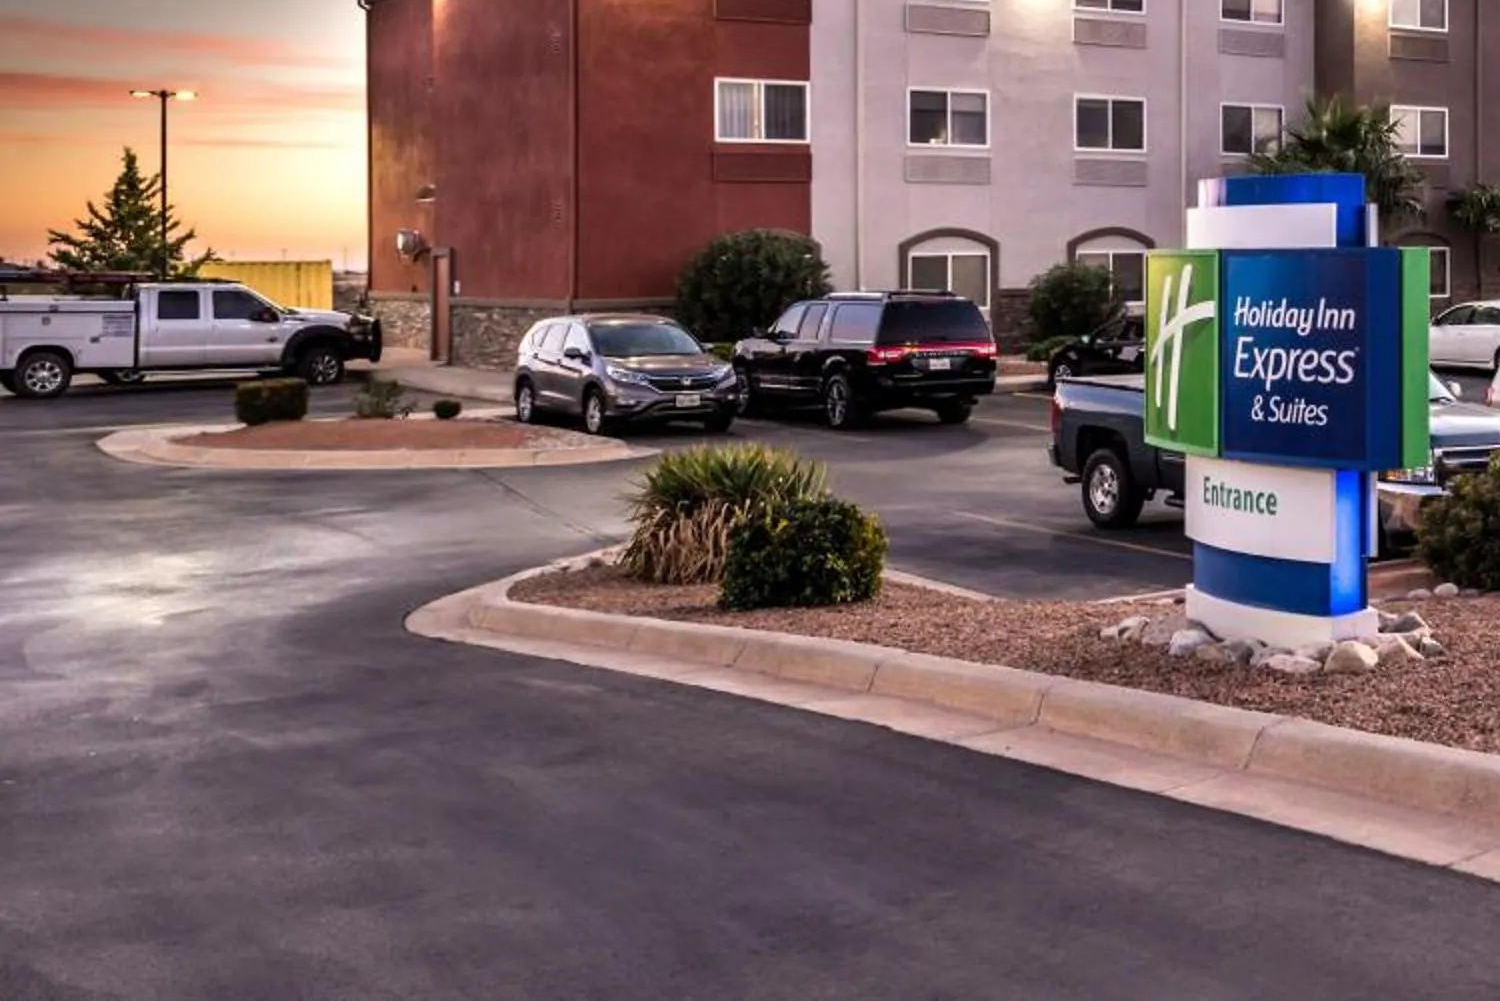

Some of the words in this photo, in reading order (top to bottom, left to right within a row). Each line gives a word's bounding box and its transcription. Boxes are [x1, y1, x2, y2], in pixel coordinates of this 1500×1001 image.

[1233, 296, 1315, 336] Holiday
[1317, 296, 1356, 330] Inn
[1234, 336, 1356, 392] Express
[1251, 394, 1265, 421] &
[1267, 395, 1329, 426] Suites
[1203, 476, 1278, 516] Entrance
